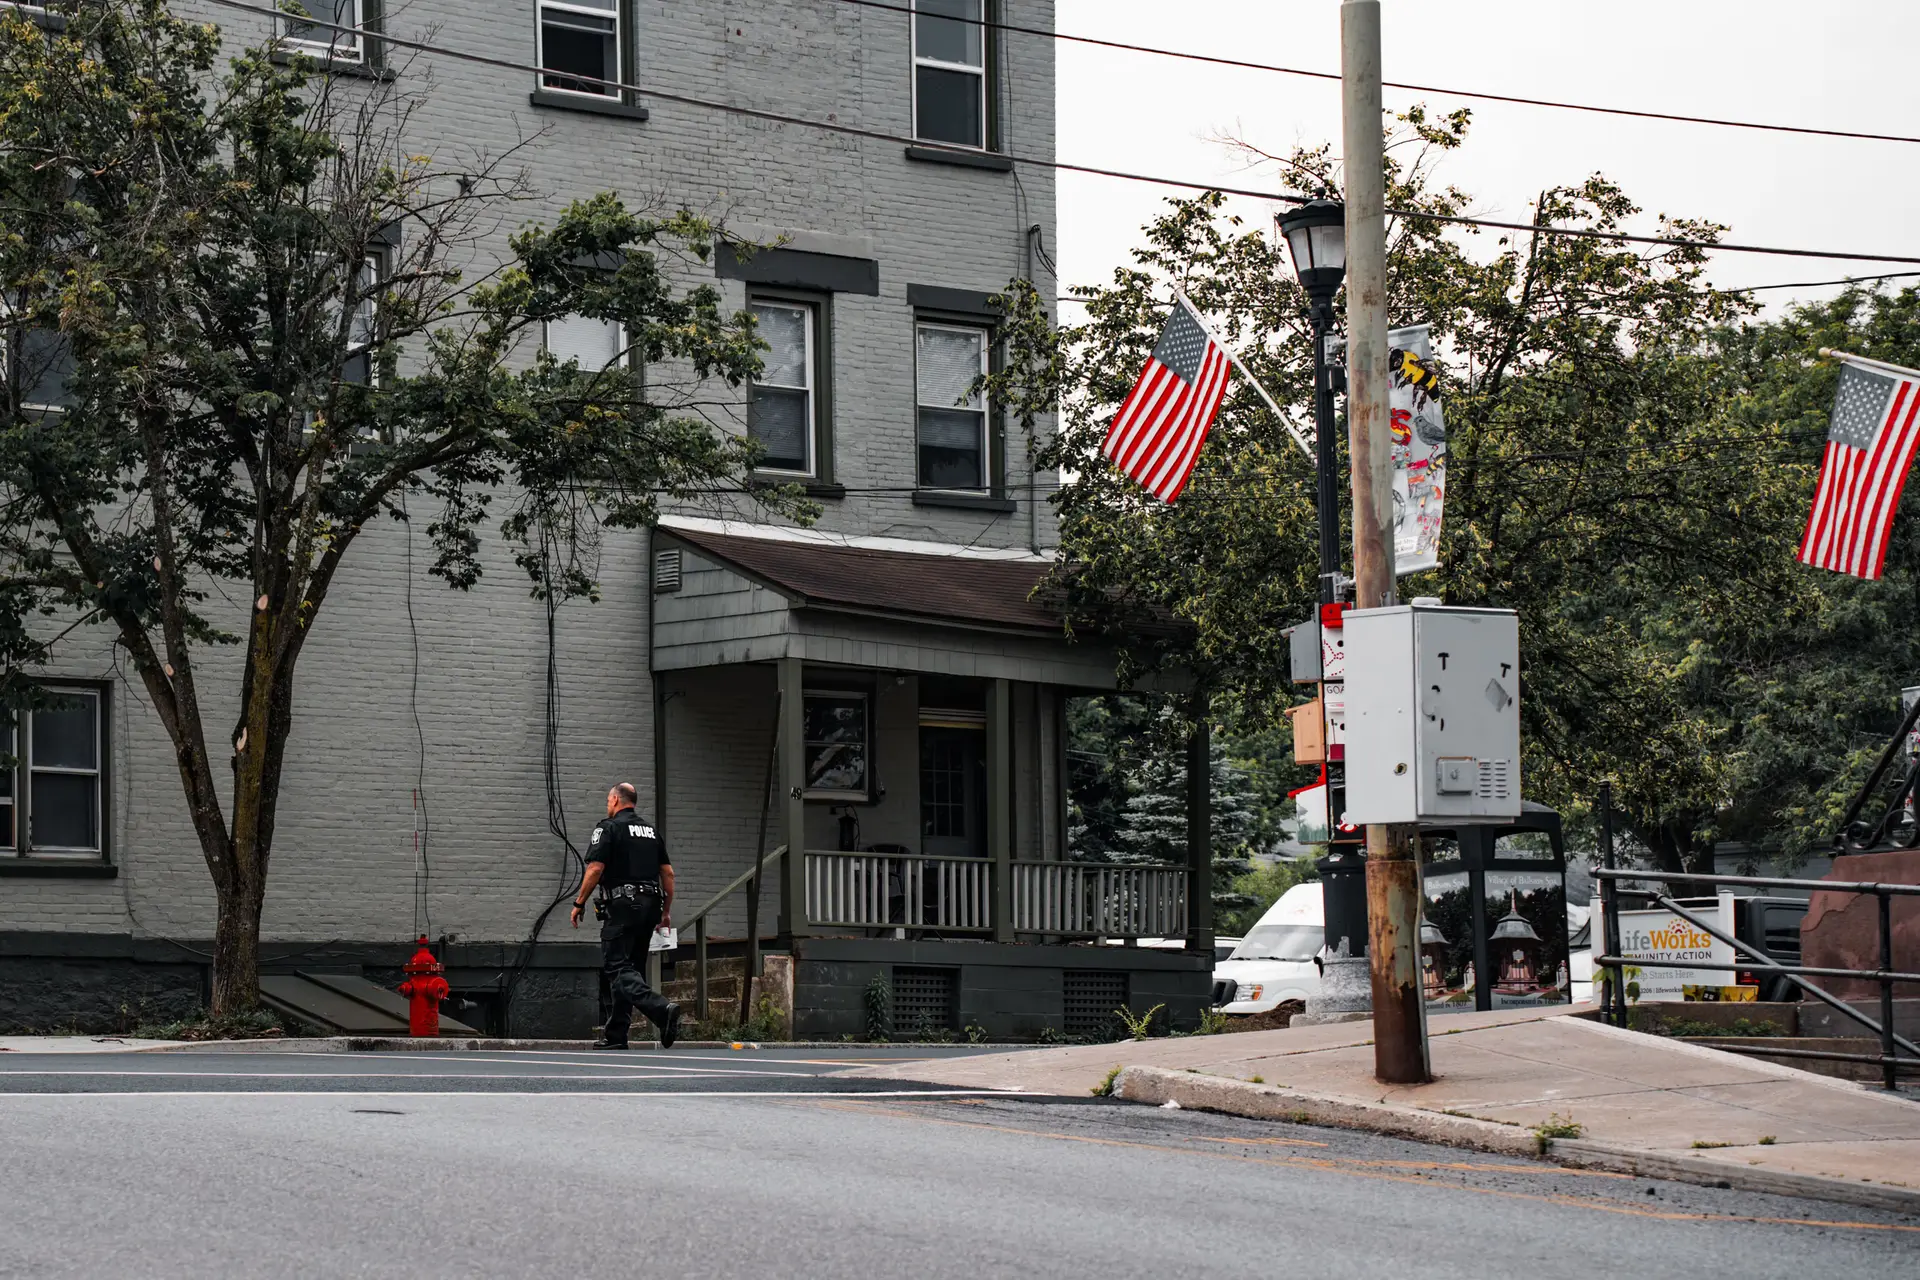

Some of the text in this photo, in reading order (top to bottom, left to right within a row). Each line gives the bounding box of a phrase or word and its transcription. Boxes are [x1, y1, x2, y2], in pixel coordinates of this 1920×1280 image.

[628, 824, 656, 840] POLICE
[1675, 951, 1711, 960] ACTION
[1649, 970, 1673, 980] Starts
